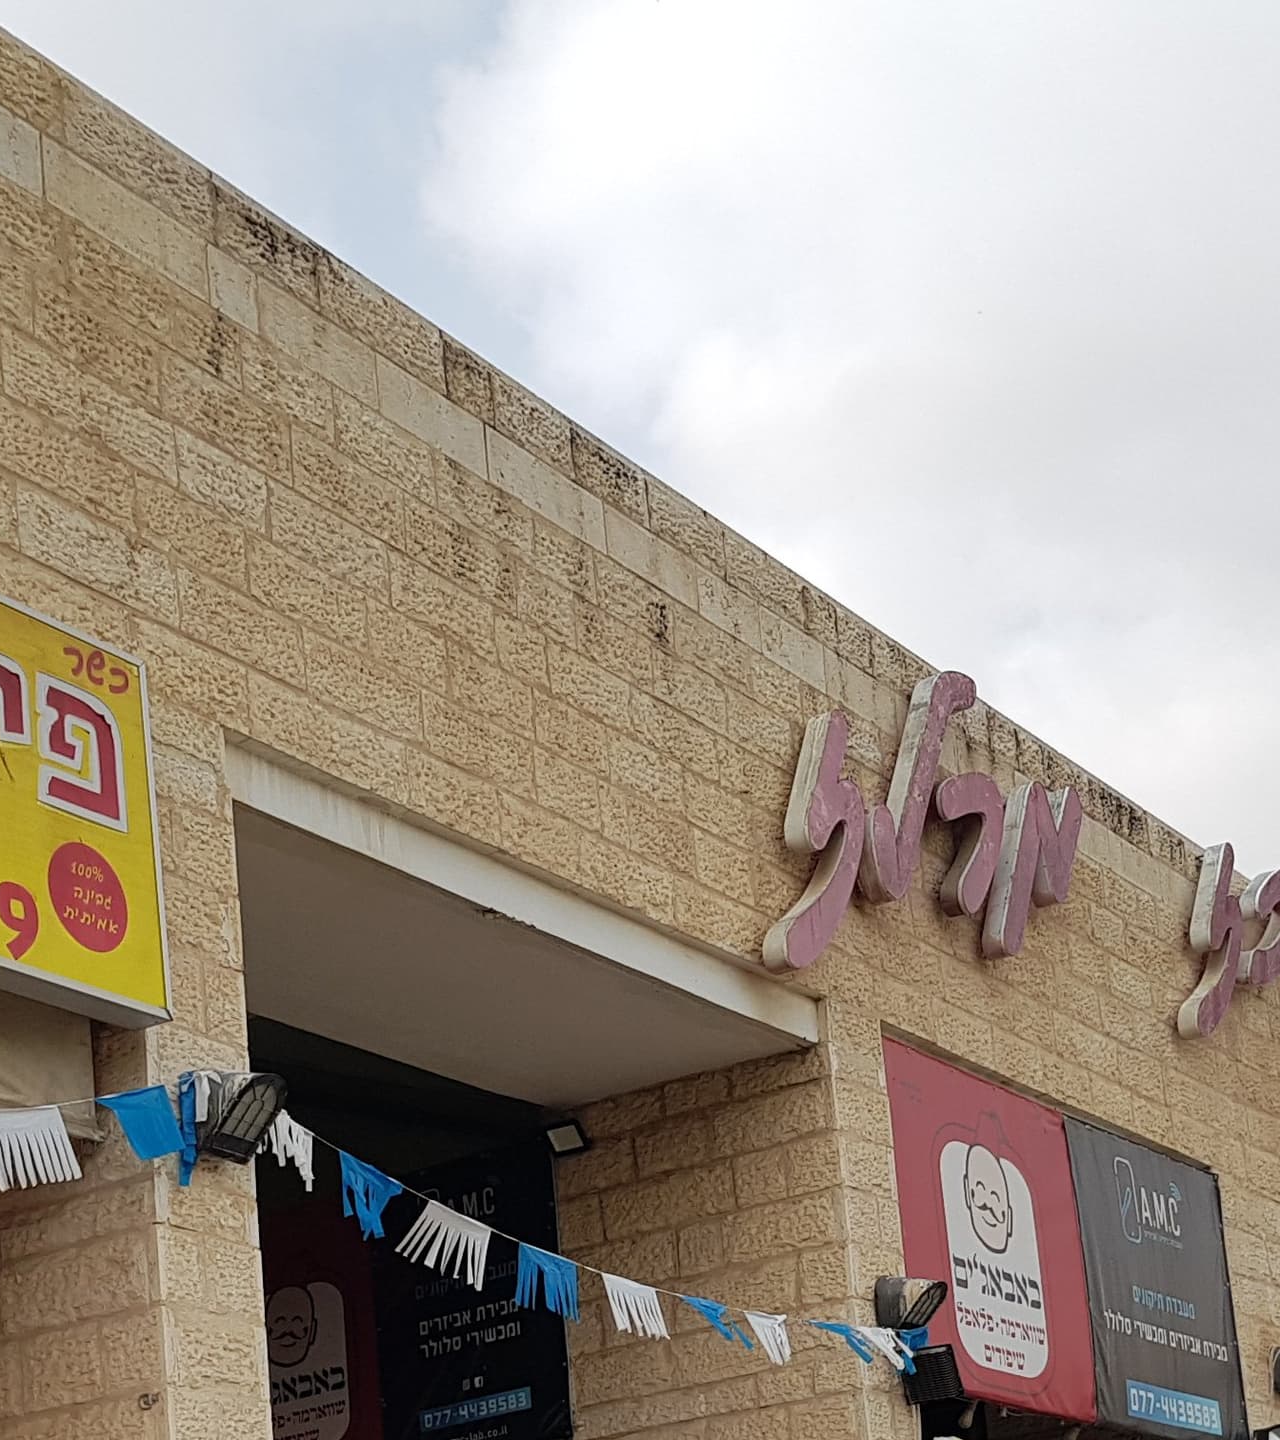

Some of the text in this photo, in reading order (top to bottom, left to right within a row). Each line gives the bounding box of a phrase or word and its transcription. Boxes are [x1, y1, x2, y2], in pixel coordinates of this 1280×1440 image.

[62, 646, 130, 694] כשר
[71, 861, 104, 882] 100%
[73, 886, 112, 910] גבינה
[63, 905, 119, 934] אמיתית
[1140, 1186, 1181, 1237] A.M.C
[953, 1253, 1042, 1310] באבאג'ים
[419, 1308, 471, 1336] אביזרים
[420, 1320, 521, 1360] ומכשירי סלולר
[1104, 1308, 1229, 1362] מכירת אביזרים ומכשירי סלולר
[984, 1344, 1026, 1370] שיפודים
[423, 1391, 528, 1429] 077-4439583
[1129, 1387, 1219, 1428] 077-4439583
